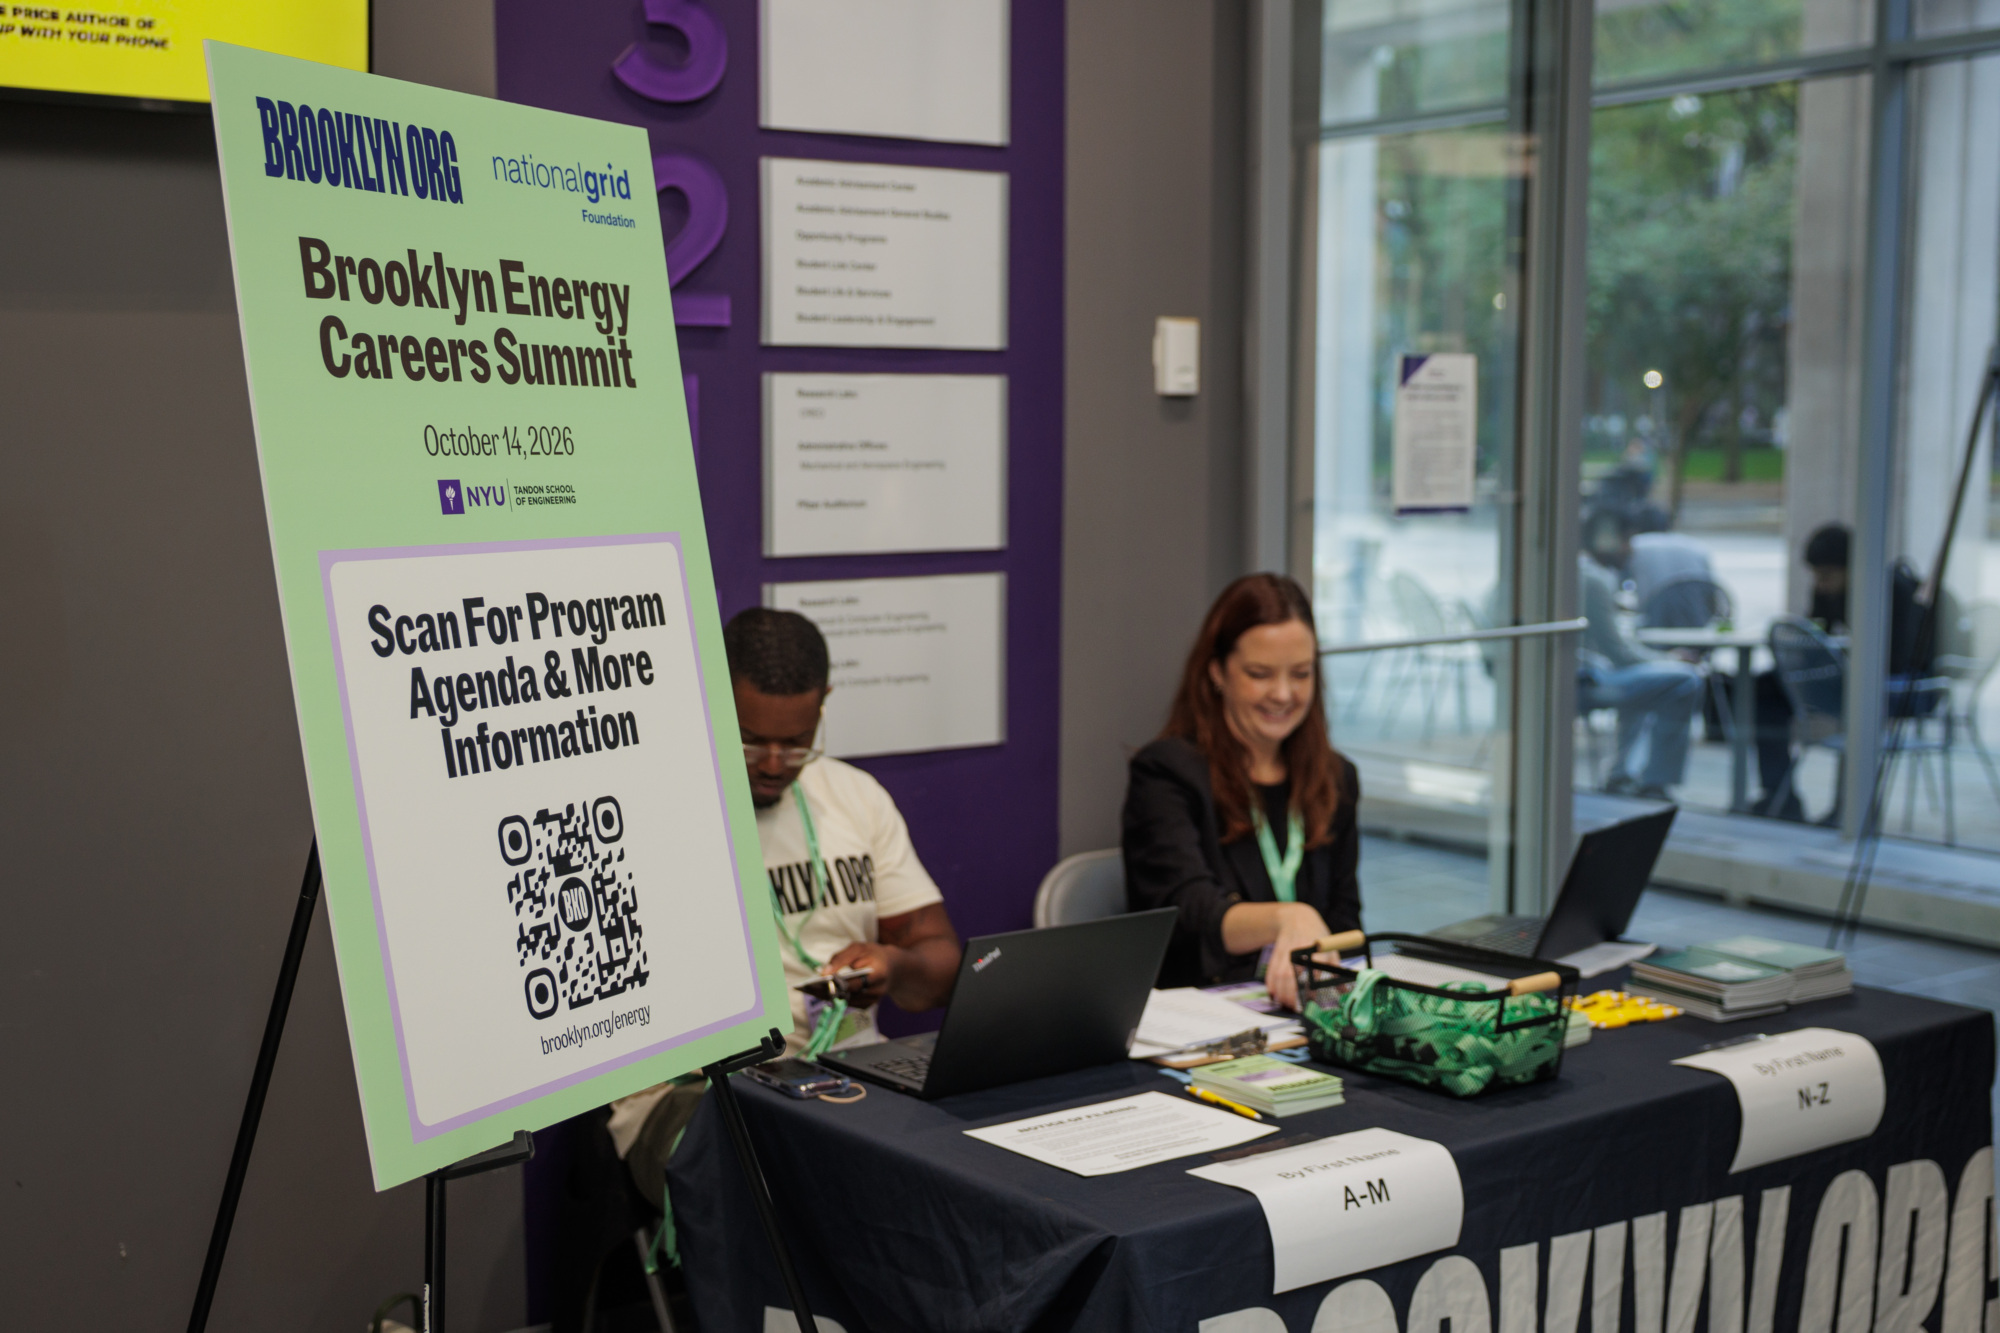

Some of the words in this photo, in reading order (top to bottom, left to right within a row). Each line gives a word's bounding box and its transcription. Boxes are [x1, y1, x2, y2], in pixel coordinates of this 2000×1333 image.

[13, 6, 60, 20] PRICE
[21, 26, 62, 39] WITH
[68, 31, 110, 43] YOUR
[116, 35, 169, 49] PHONE
[255, 96, 409, 197] BROOKLYN
[406, 124, 464, 205] ORG
[492, 154, 632, 204] nationalgrid
[582, 209, 636, 229] Foundation
[652, 155, 731, 326] 2
[298, 236, 498, 326] Brooklyn
[499, 258, 630, 336] Energy
[319, 314, 491, 384] Careers
[493, 327, 637, 388] Summit
[424, 424, 499, 457] October
[527, 425, 575, 456] 2026
[466, 485, 506, 507] NYU
[513, 486, 545, 495] TANDON
[546, 484, 576, 494] SCHOOL
[516, 497, 527, 506] OF
[528, 495, 577, 505] ENGINEERING
[367, 604, 462, 658] Scan
[462, 596, 523, 647] For
[526, 592, 666, 645] Program
[410, 655, 541, 727] Agenda
[544, 650, 573, 700] &
[571, 646, 654, 695] More
[441, 705, 640, 779] Information
[561, 886, 589, 923] BKO
[540, 1004, 651, 1056] brooklyn.org/energy
[1752, 1062, 1777, 1077] By
[1802, 1046, 1845, 1062] Name
[1797, 1081, 1832, 1111] N-Z
[1277, 1169, 1306, 1180] By
[1302, 1158, 1350, 1174] First
[1346, 1148, 1401, 1164] Name
[1344, 1177, 1391, 1211] A-M
